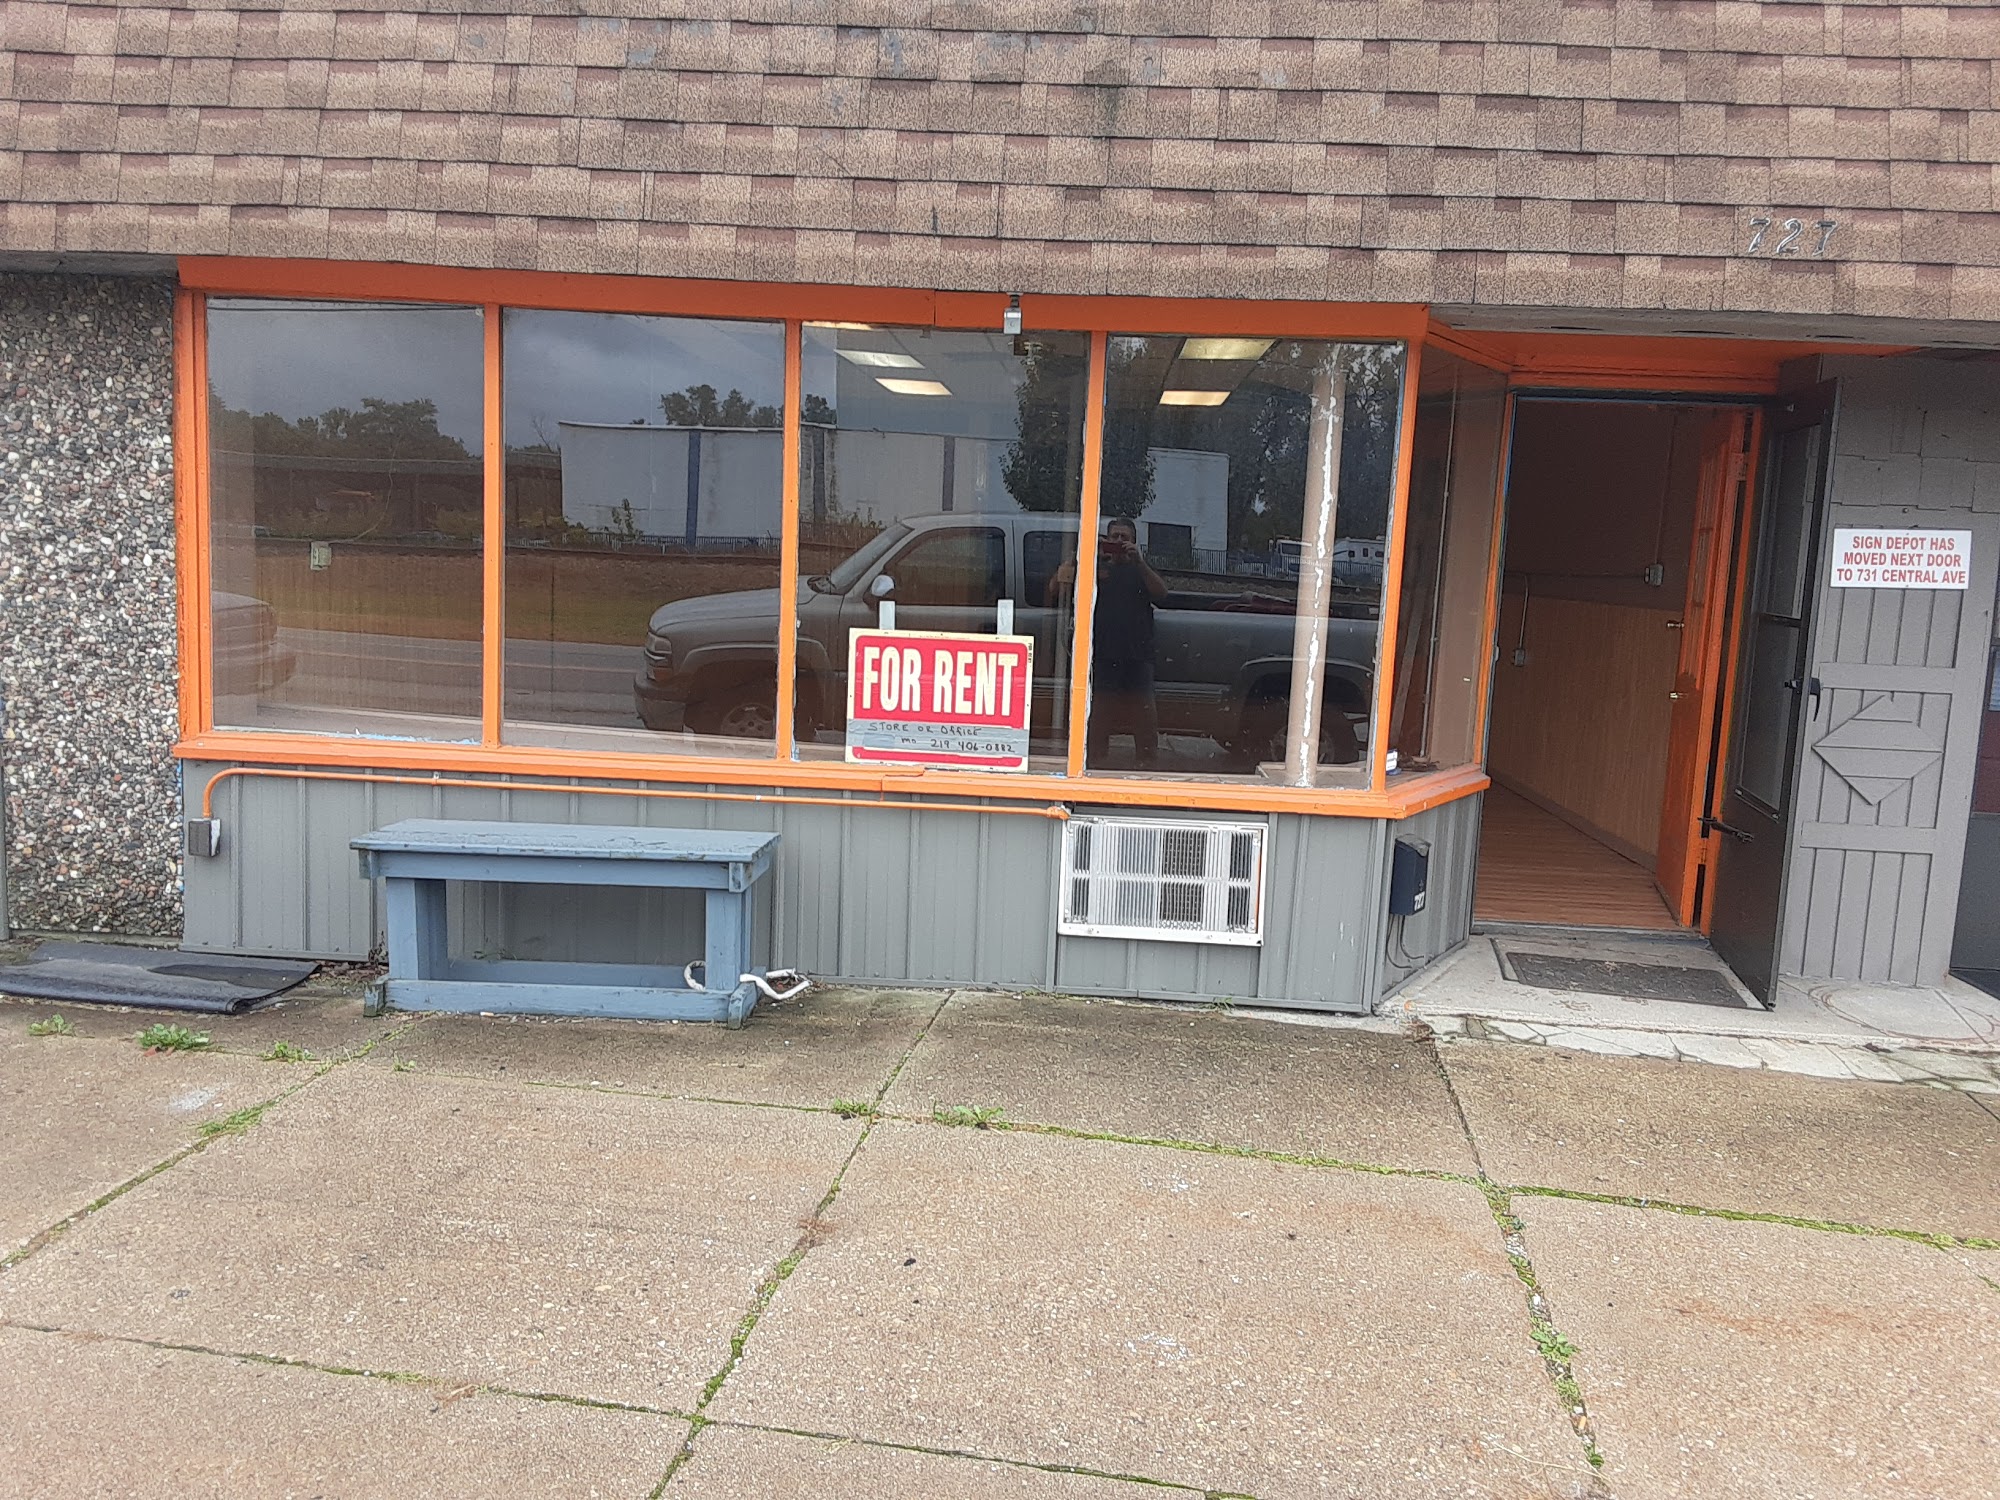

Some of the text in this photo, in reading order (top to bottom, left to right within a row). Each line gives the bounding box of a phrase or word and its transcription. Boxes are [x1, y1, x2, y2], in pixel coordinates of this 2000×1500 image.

[1748, 217, 1838, 257] 727
[1852, 535, 1955, 551] SIGN DEPOT HAS
[1844, 552, 1961, 567] MOVED NEXT DOOR
[1837, 569, 1966, 584] TO 731 CENTRAL AVE
[863, 646, 1018, 716] FOR RENT
[867, 722, 909, 732] STORE
[930, 739, 950, 749] 219
